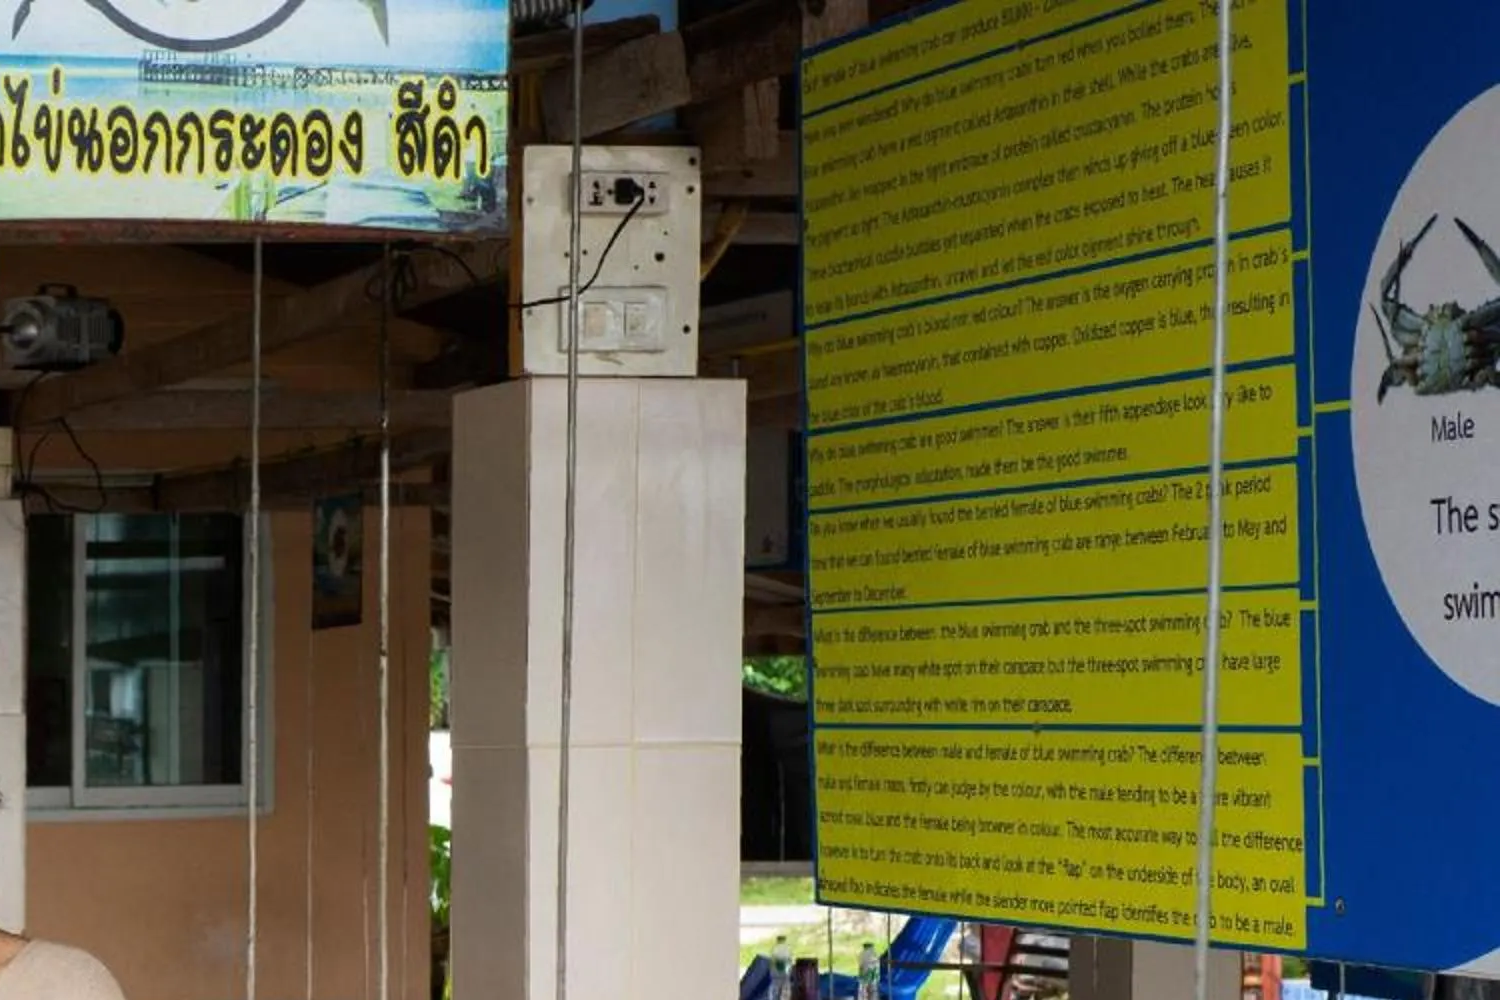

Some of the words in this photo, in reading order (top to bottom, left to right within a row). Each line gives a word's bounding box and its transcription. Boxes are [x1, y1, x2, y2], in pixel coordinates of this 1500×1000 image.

[395, 75, 489, 180] สีดำ
[1195, 170, 1217, 189] hea
[1229, 160, 1259, 181] auses
[1279, 290, 1290, 307] in
[1258, 381, 1272, 400] to
[1431, 411, 1475, 441] Male
[1172, 482, 1193, 501] The
[1235, 473, 1272, 499] period
[1237, 517, 1260, 540] May
[1263, 514, 1286, 534] and
[1430, 496, 1478, 535] The
[1239, 609, 1260, 627] The
[1263, 608, 1292, 627] blue
[1221, 652, 1248, 670] have
[1251, 651, 1281, 674] large
[1137, 745, 1156, 762] The
[1160, 745, 1202, 763] differen
[1158, 785, 1168, 803] to
[1172, 785, 1186, 803] be
[1066, 821, 1085, 838] The
[1161, 830, 1182, 848] way
[1185, 827, 1197, 845] to
[1221, 829, 1240, 847] the
[1243, 830, 1302, 851] difference
[1105, 862, 1123, 880] the
[1126, 864, 1177, 884] underside
[1180, 868, 1193, 885] of
[1217, 870, 1249, 894] body,
[1252, 877, 1266, 891] an
[1235, 912, 1250, 931] be
[1253, 919, 1260, 933] a
